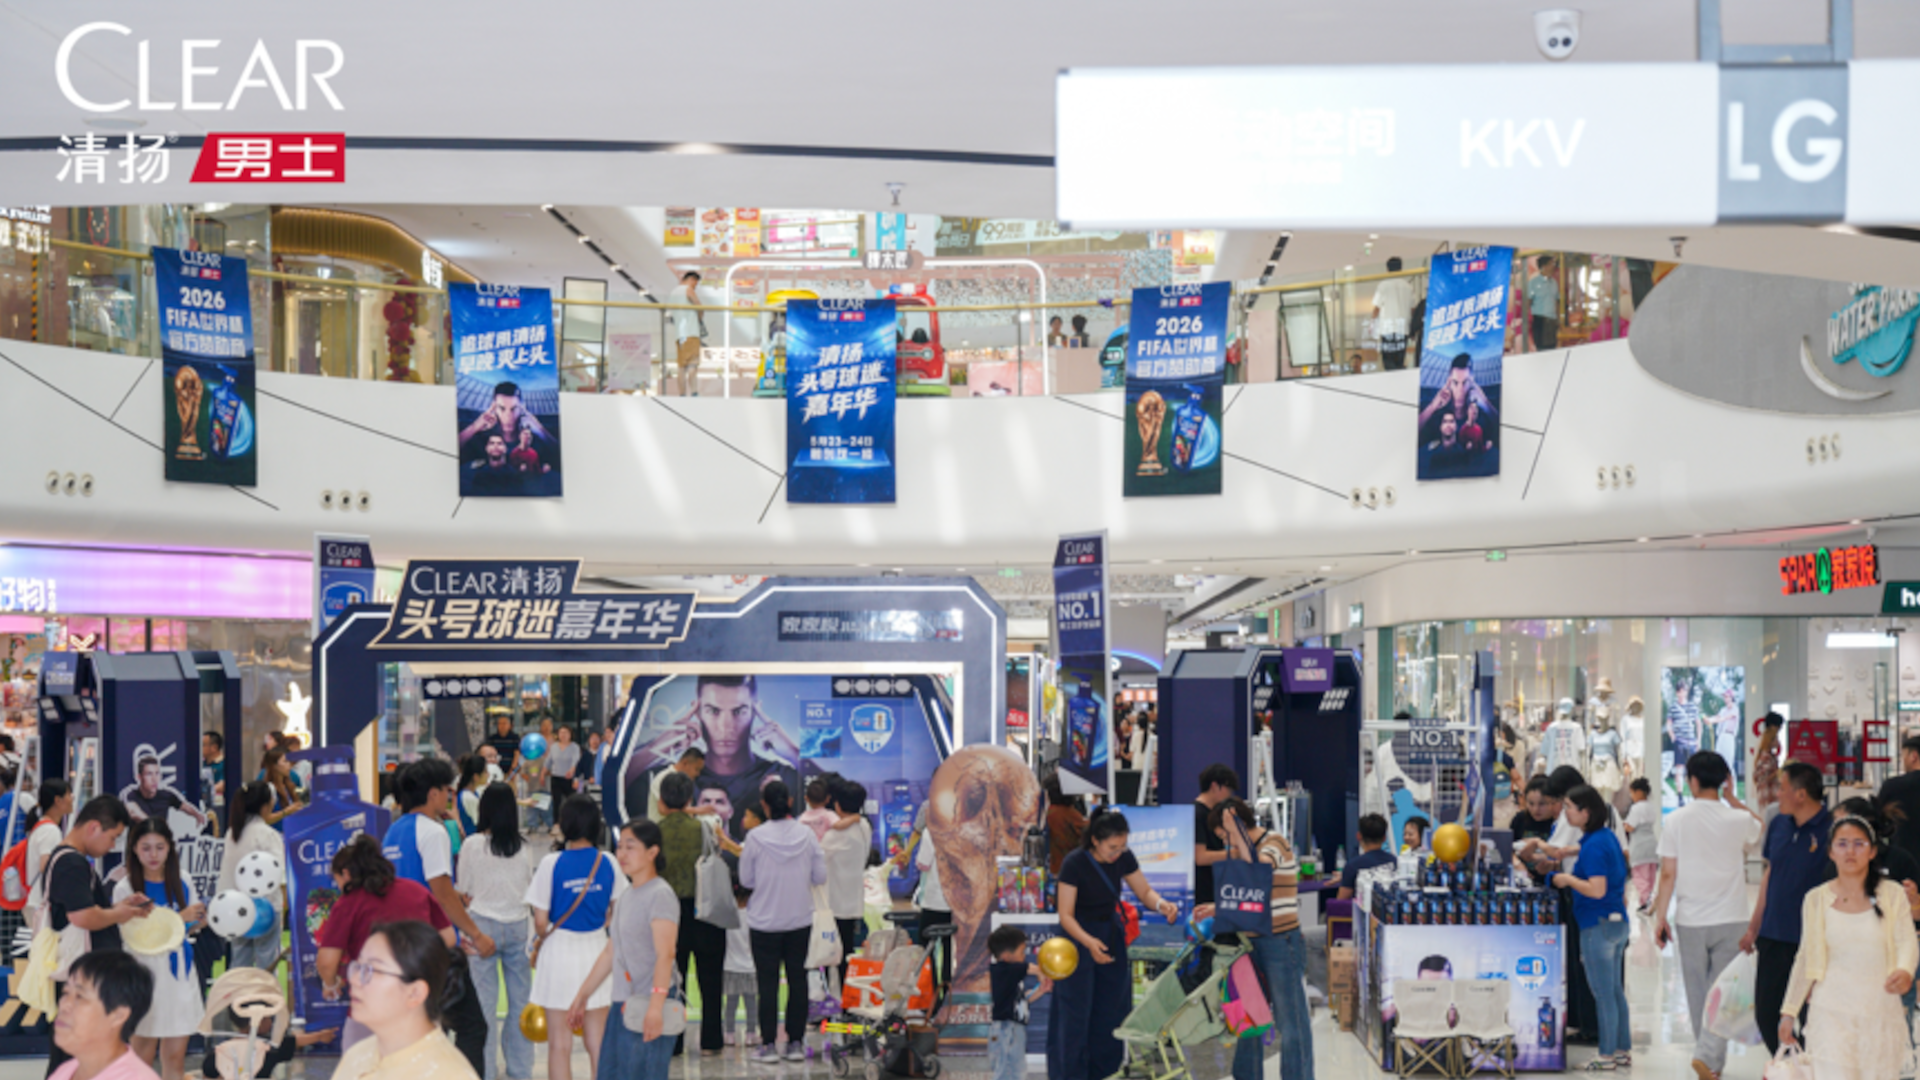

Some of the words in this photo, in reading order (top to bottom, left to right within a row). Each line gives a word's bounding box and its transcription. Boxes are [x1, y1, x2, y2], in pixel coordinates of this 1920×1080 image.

[1459, 118, 1586, 168] KKV
[1727, 99, 1843, 183] LG
[180, 250, 222, 269] CLEAR
[180, 286, 226, 311] 2026
[817, 297, 865, 311] CLEAR
[1156, 315, 1203, 335] 2026
[1827, 292, 1880, 357] WATER
[795, 360, 890, 397] 头号球迷
[801, 387, 882, 425] 嘉年华
[326, 543, 362, 558] CLEAR
[1064, 542, 1095, 556] CLEAR
[411, 567, 497, 595] CLEAR
[501, 566, 563, 595] 清扬
[1779, 552, 1818, 595] SPAR
[1058, 591, 1100, 619] NO.1
[397, 599, 682, 640] 头号球迷嘉年华
[1409, 730, 1458, 746] NO.1
[298, 840, 347, 864] CLEA
[1220, 884, 1265, 902] CLEAR
